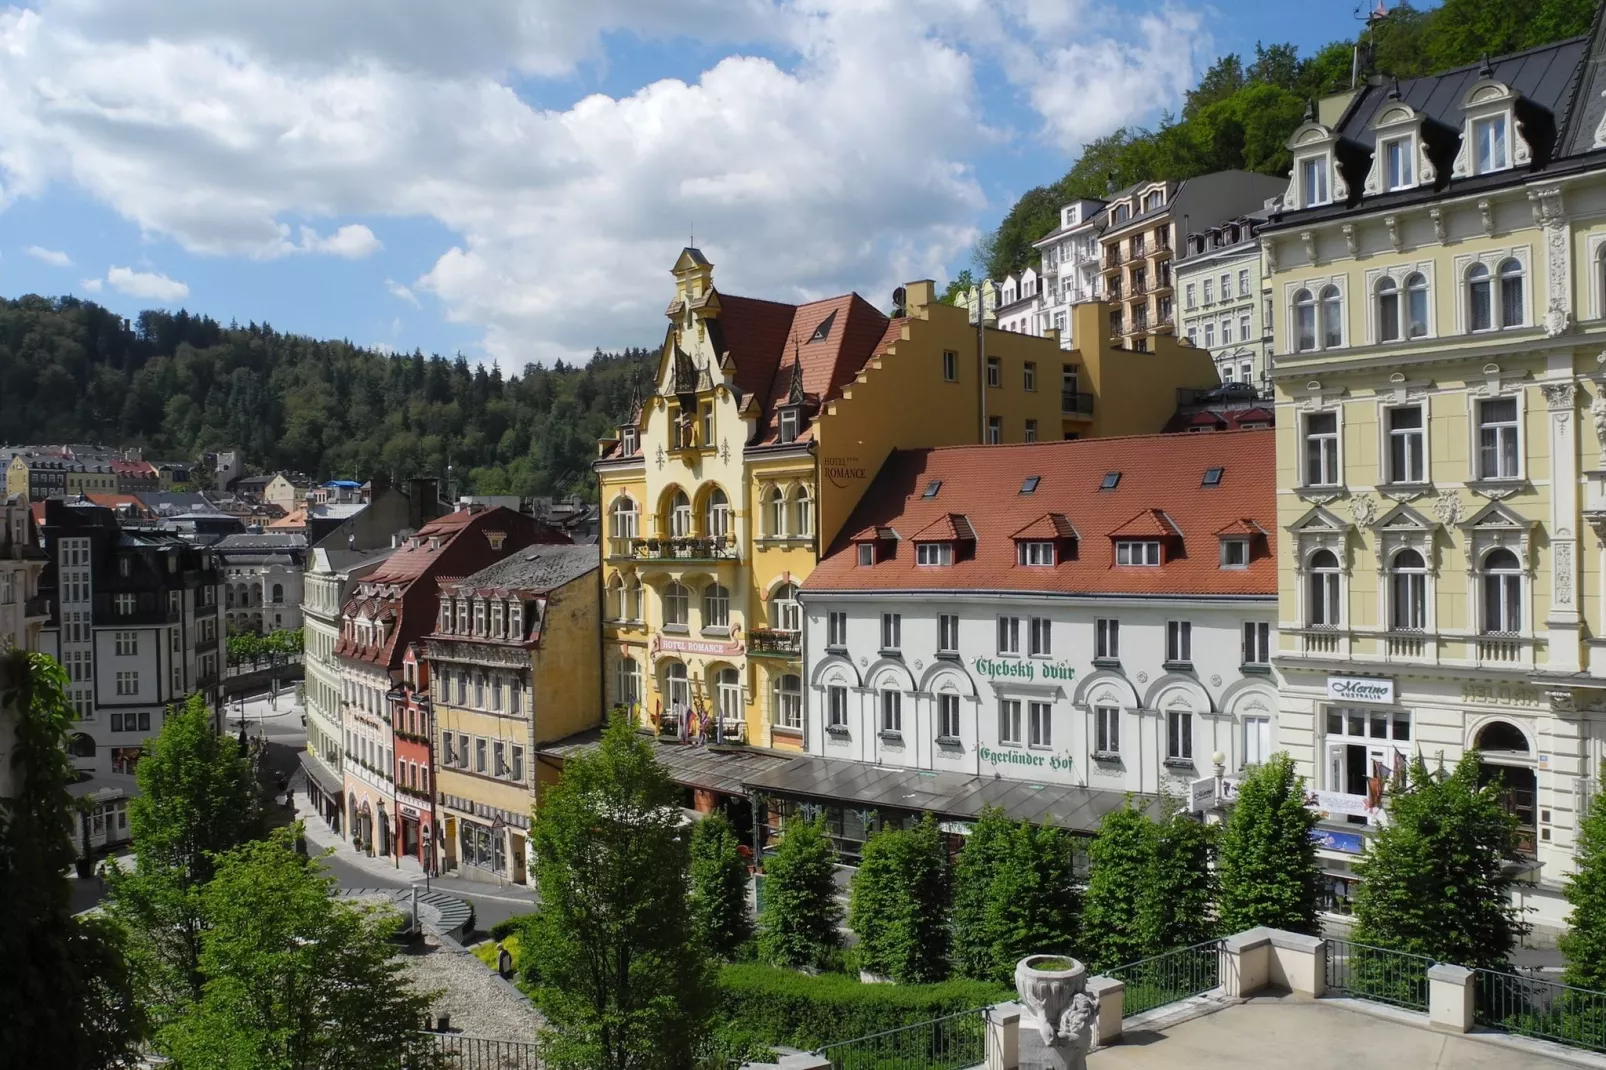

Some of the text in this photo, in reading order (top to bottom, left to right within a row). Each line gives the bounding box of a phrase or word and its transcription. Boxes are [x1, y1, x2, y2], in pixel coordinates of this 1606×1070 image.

[824, 457, 846, 466] HOTEL
[824, 467, 867, 482] ROMANCE
[662, 640, 724, 654] HOTEL ROMANCE
[976, 658, 1075, 681] Chebský dvůr
[1340, 691, 1382, 700] AUSTRALIA
[980, 747, 1073, 774] Egerländer Hof
